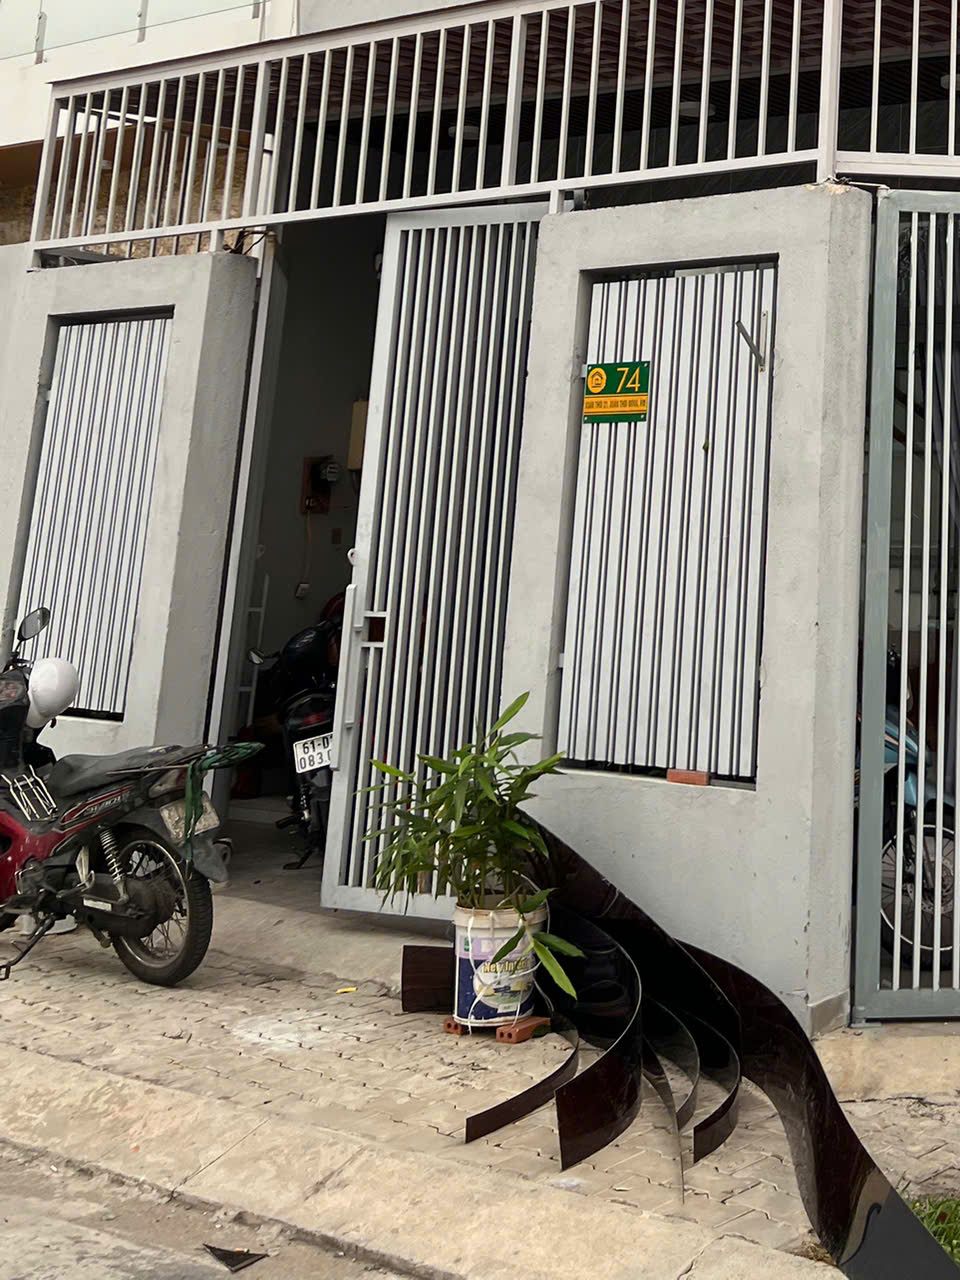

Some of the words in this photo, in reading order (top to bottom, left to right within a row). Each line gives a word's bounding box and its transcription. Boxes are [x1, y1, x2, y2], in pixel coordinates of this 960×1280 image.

[616, 367, 641, 393] 74
[302, 733, 333, 755] 61-D
[299, 749, 331, 770] 083.
